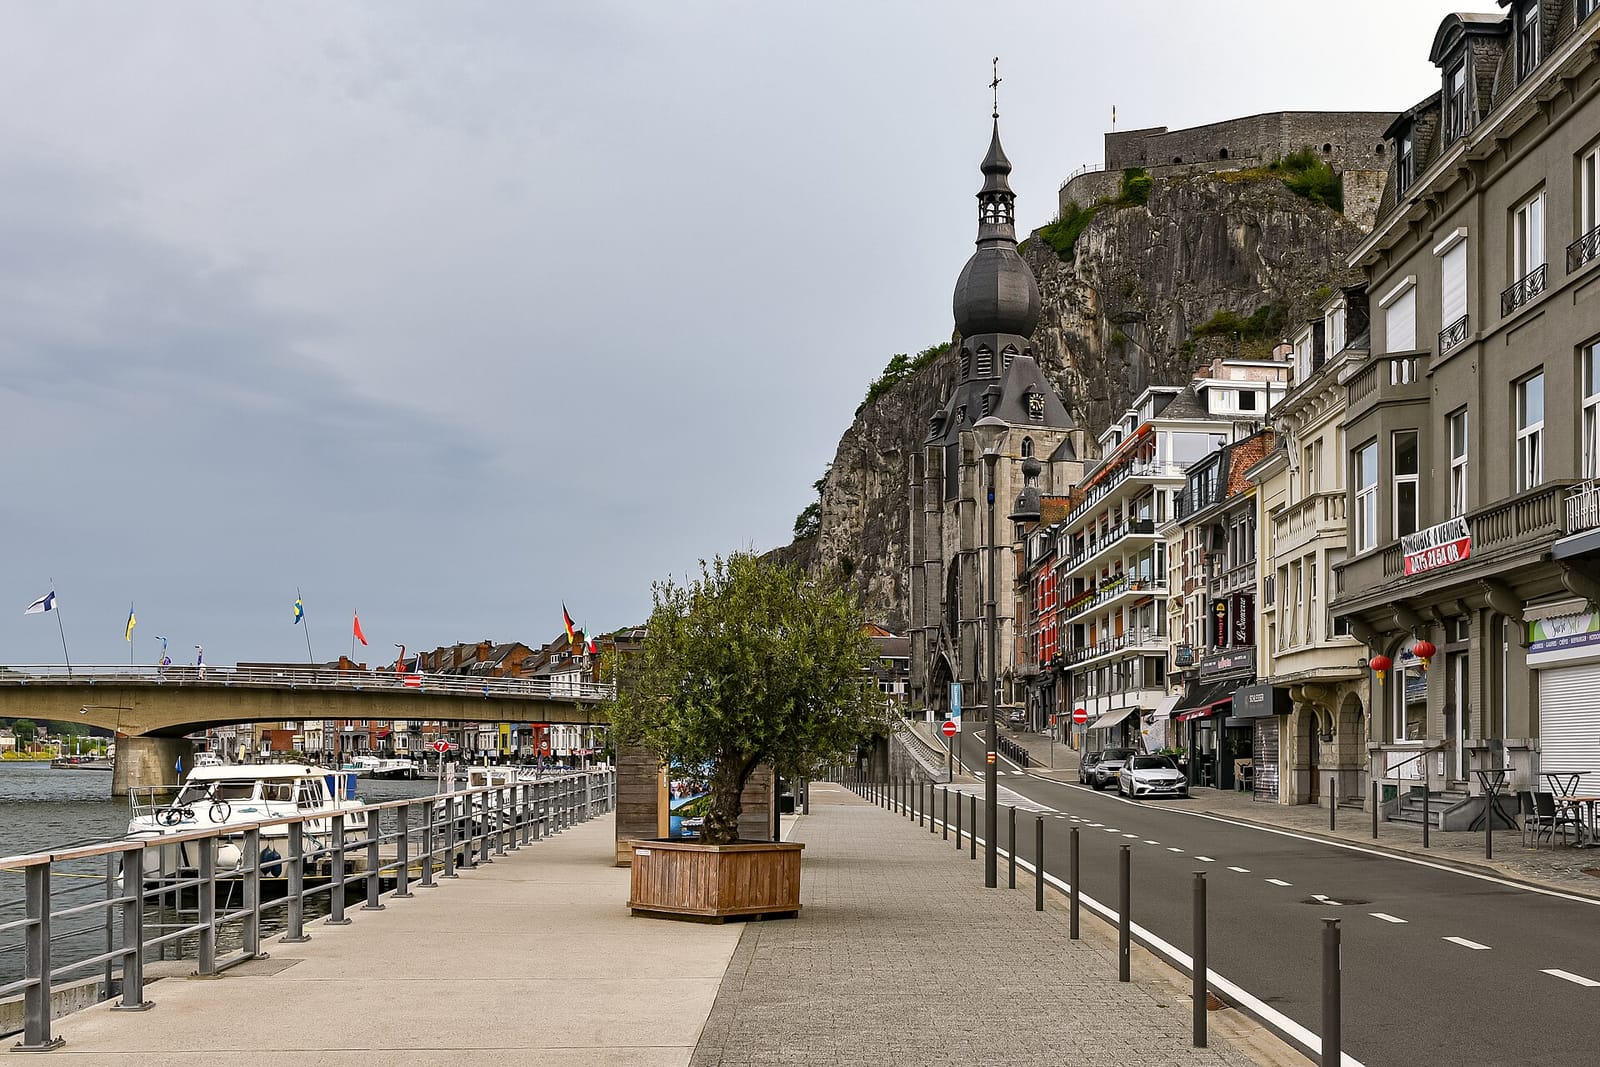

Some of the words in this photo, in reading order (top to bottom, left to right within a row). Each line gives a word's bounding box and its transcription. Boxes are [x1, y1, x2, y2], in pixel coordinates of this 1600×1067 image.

[1439, 520, 1466, 543] VENDRE
[1437, 547, 1447, 565] 54
[1236, 630, 1246, 643] Le
[437, 741, 446, 751] 7
